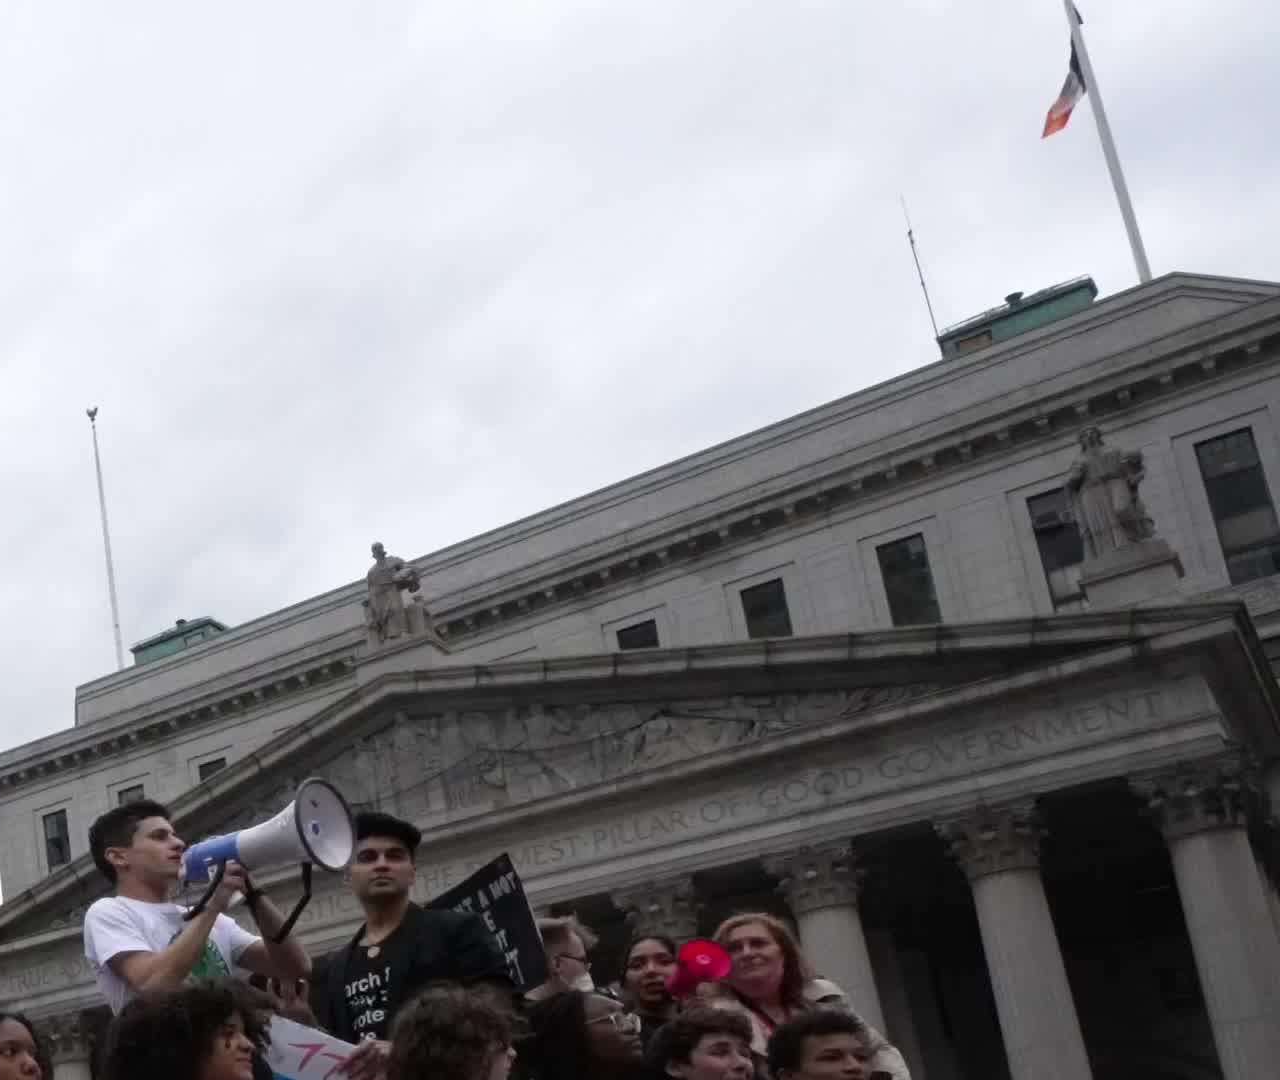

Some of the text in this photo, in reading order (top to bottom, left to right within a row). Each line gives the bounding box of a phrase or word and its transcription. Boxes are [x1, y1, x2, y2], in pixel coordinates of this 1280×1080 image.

[592, 808, 690, 849] PILLAR
[757, 767, 864, 809] GOOD
[877, 690, 1162, 779] GOVERNMENT
